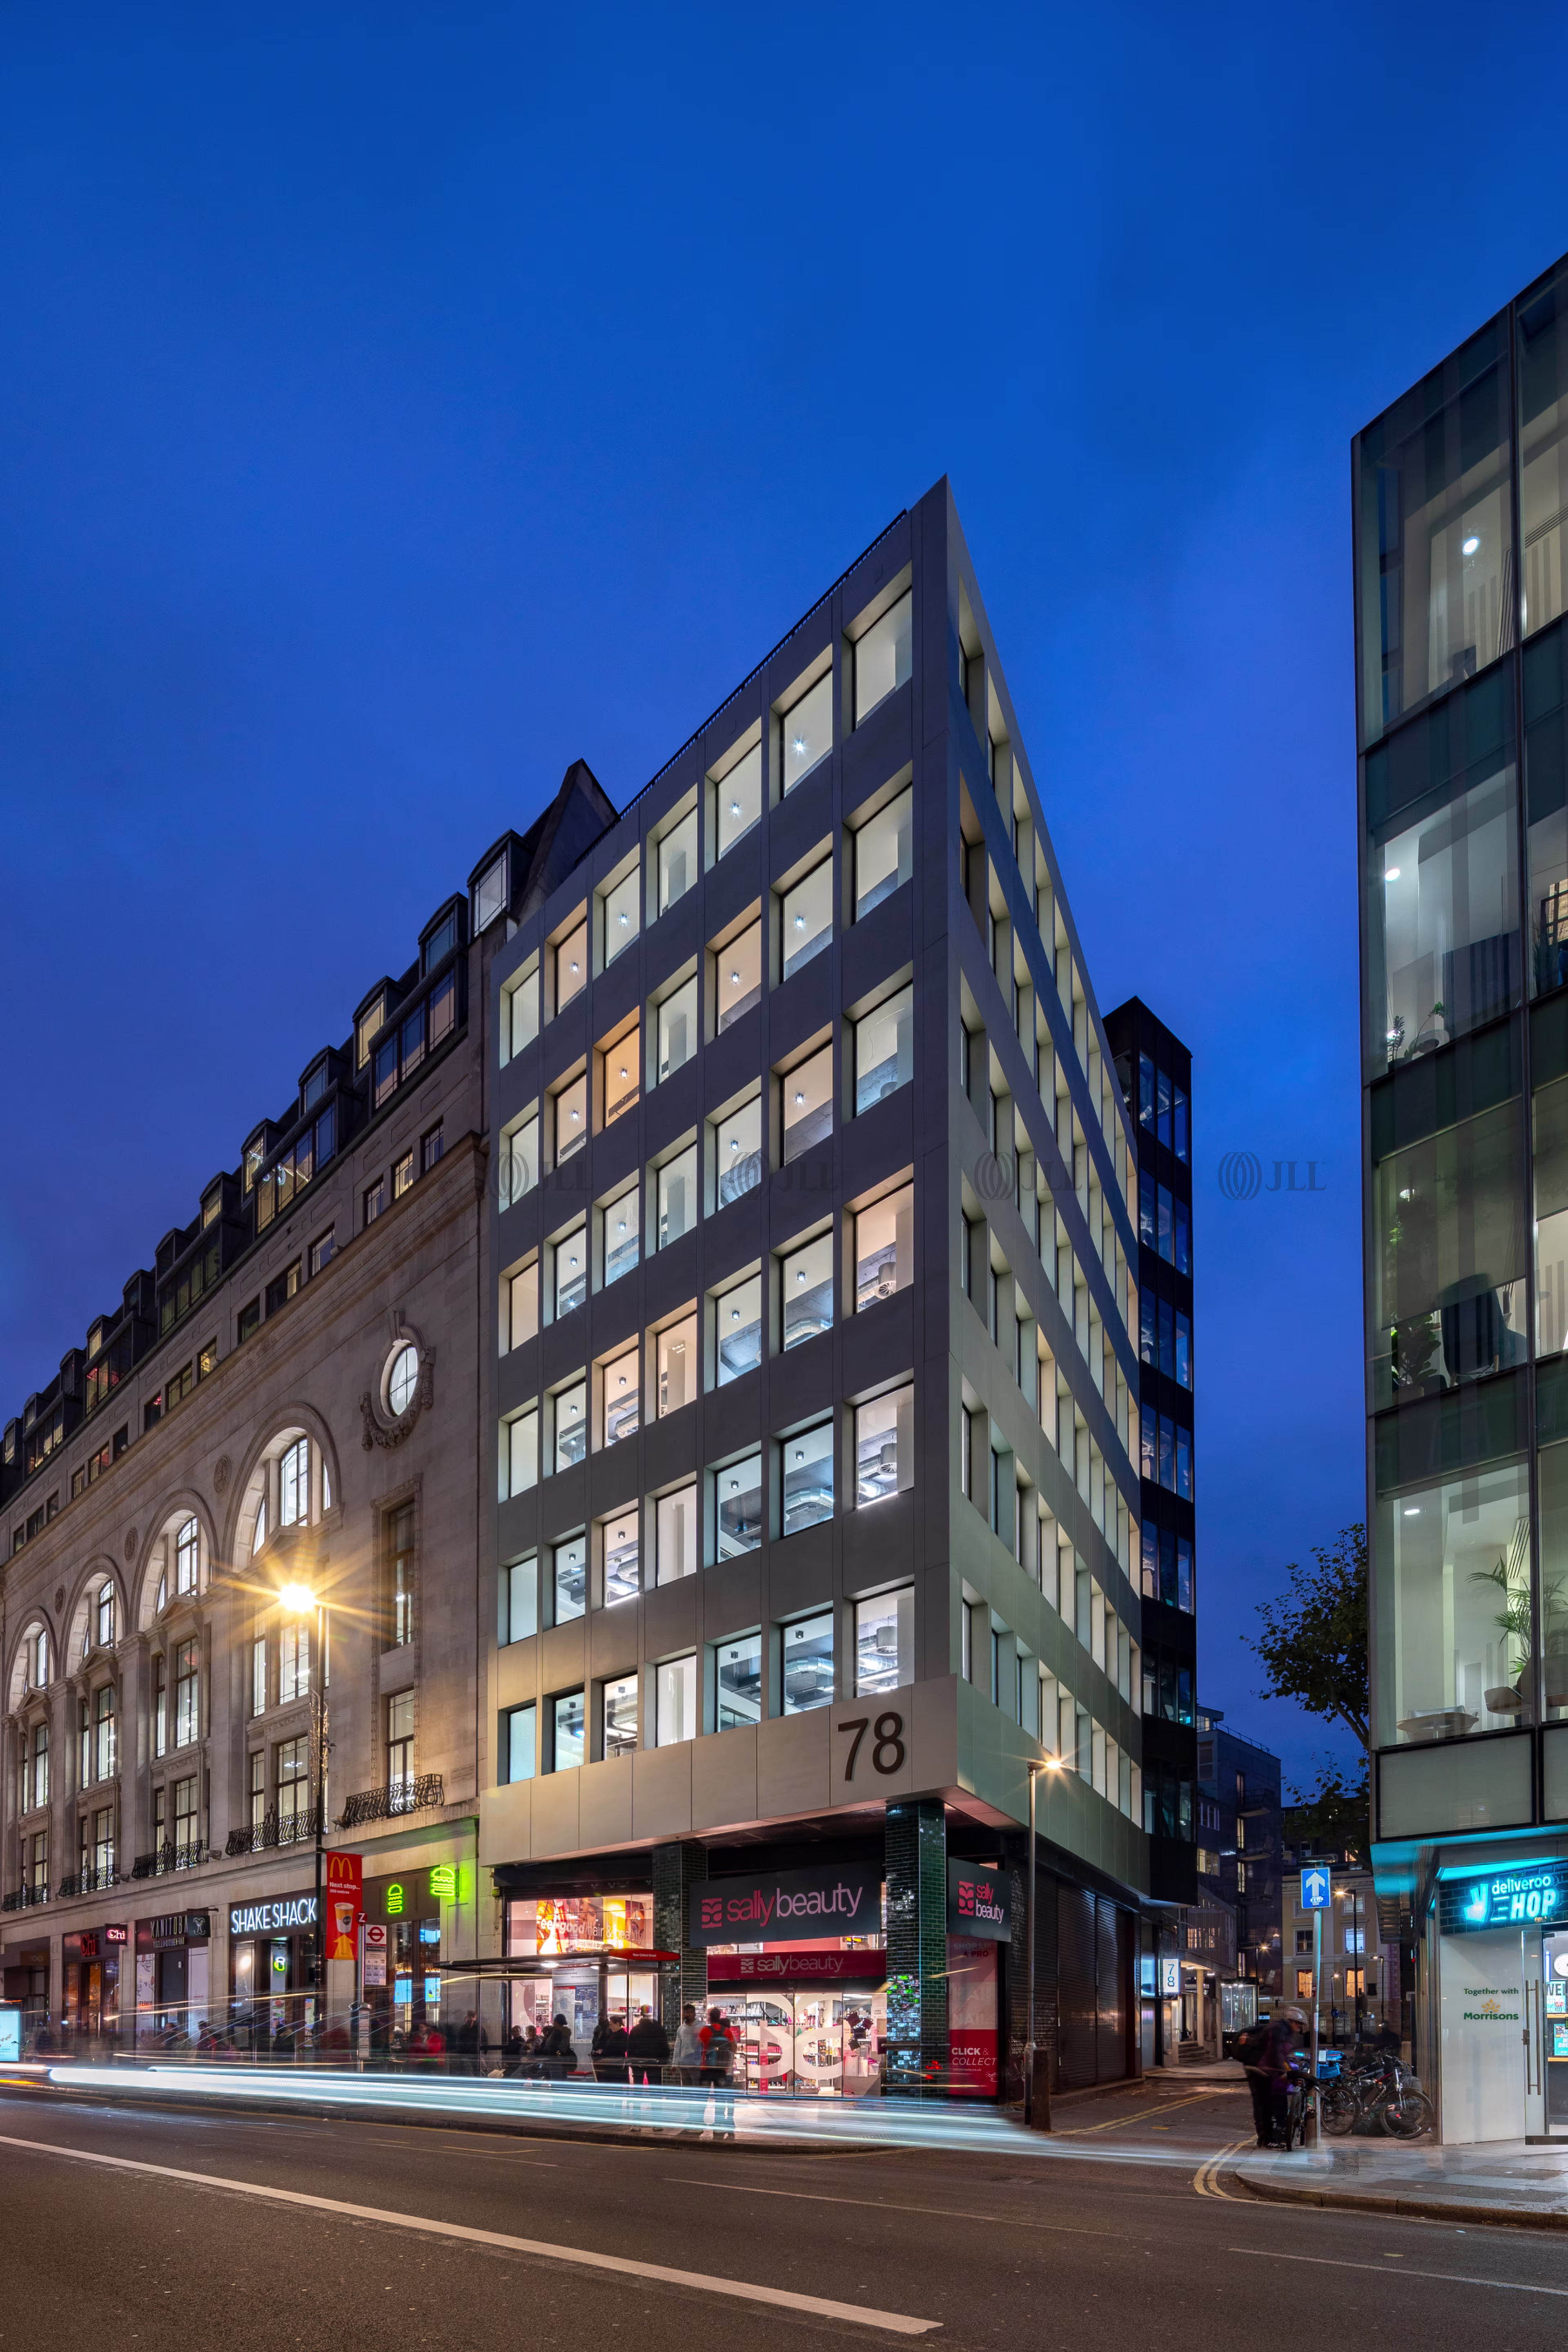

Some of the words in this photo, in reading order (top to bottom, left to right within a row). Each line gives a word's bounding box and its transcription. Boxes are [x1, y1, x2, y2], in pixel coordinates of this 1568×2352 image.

[838, 1712, 904, 1781] 78
[976, 1882, 994, 1904] sally
[1492, 1876, 1551, 1895] deliveroo
[976, 1899, 1004, 1924] beauty
[1510, 1889, 1556, 1919] HOP
[231, 1905, 271, 1933] SHAKE
[272, 1898, 316, 1927] SHACK
[358, 1913, 365, 1922] Z
[107, 1929, 125, 1940] Chi
[588, 1922, 604, 1937] hair
[81, 1934, 96, 1957] Chi
[1464, 1988, 1499, 1996] Together
[1464, 2011, 1519, 2020] Morrisons
[952, 2057, 997, 2066] COLLECT
